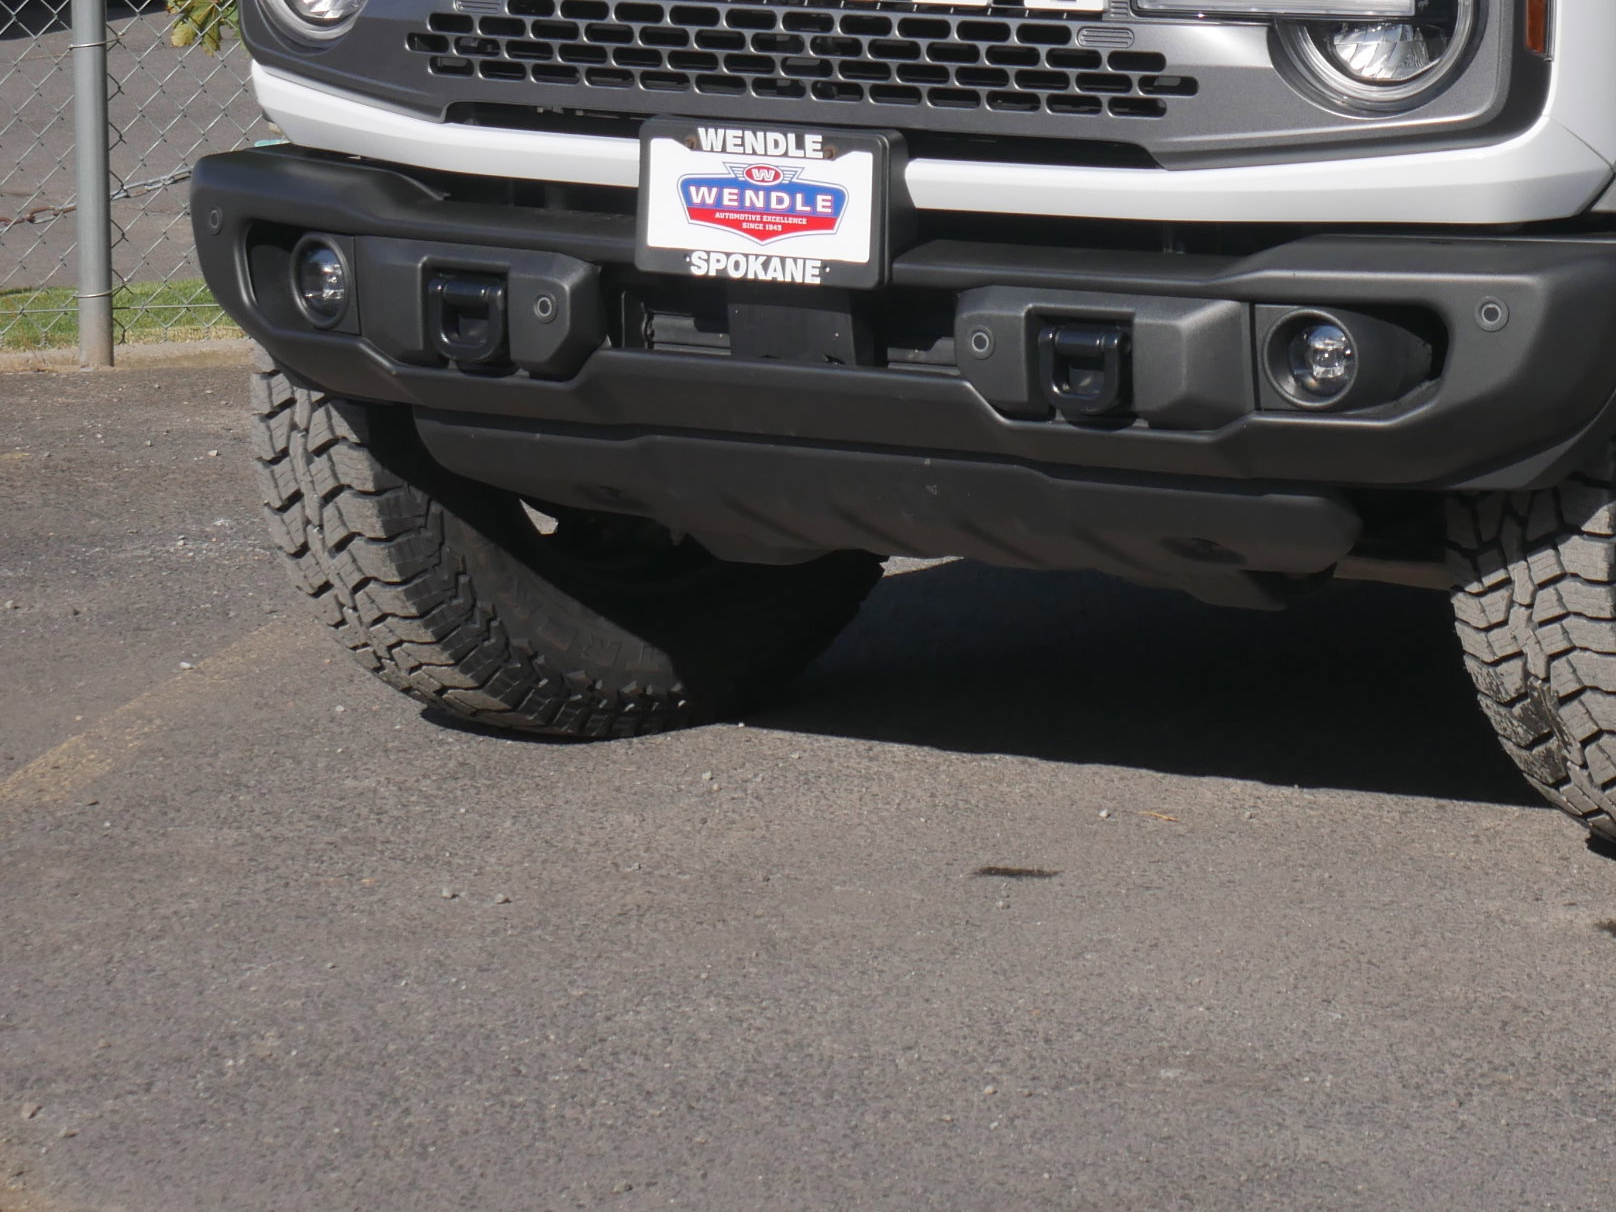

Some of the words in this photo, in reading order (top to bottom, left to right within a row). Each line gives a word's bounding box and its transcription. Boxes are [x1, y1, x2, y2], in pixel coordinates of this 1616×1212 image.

[697, 127, 824, 159] WENDLE
[688, 185, 833, 214] WENDLE
[715, 211, 761, 222] AUTOMOTIVE
[762, 215, 808, 225] EXCELLENCE
[741, 222, 764, 231] SINCE
[690, 249, 822, 285] SPOKANE
